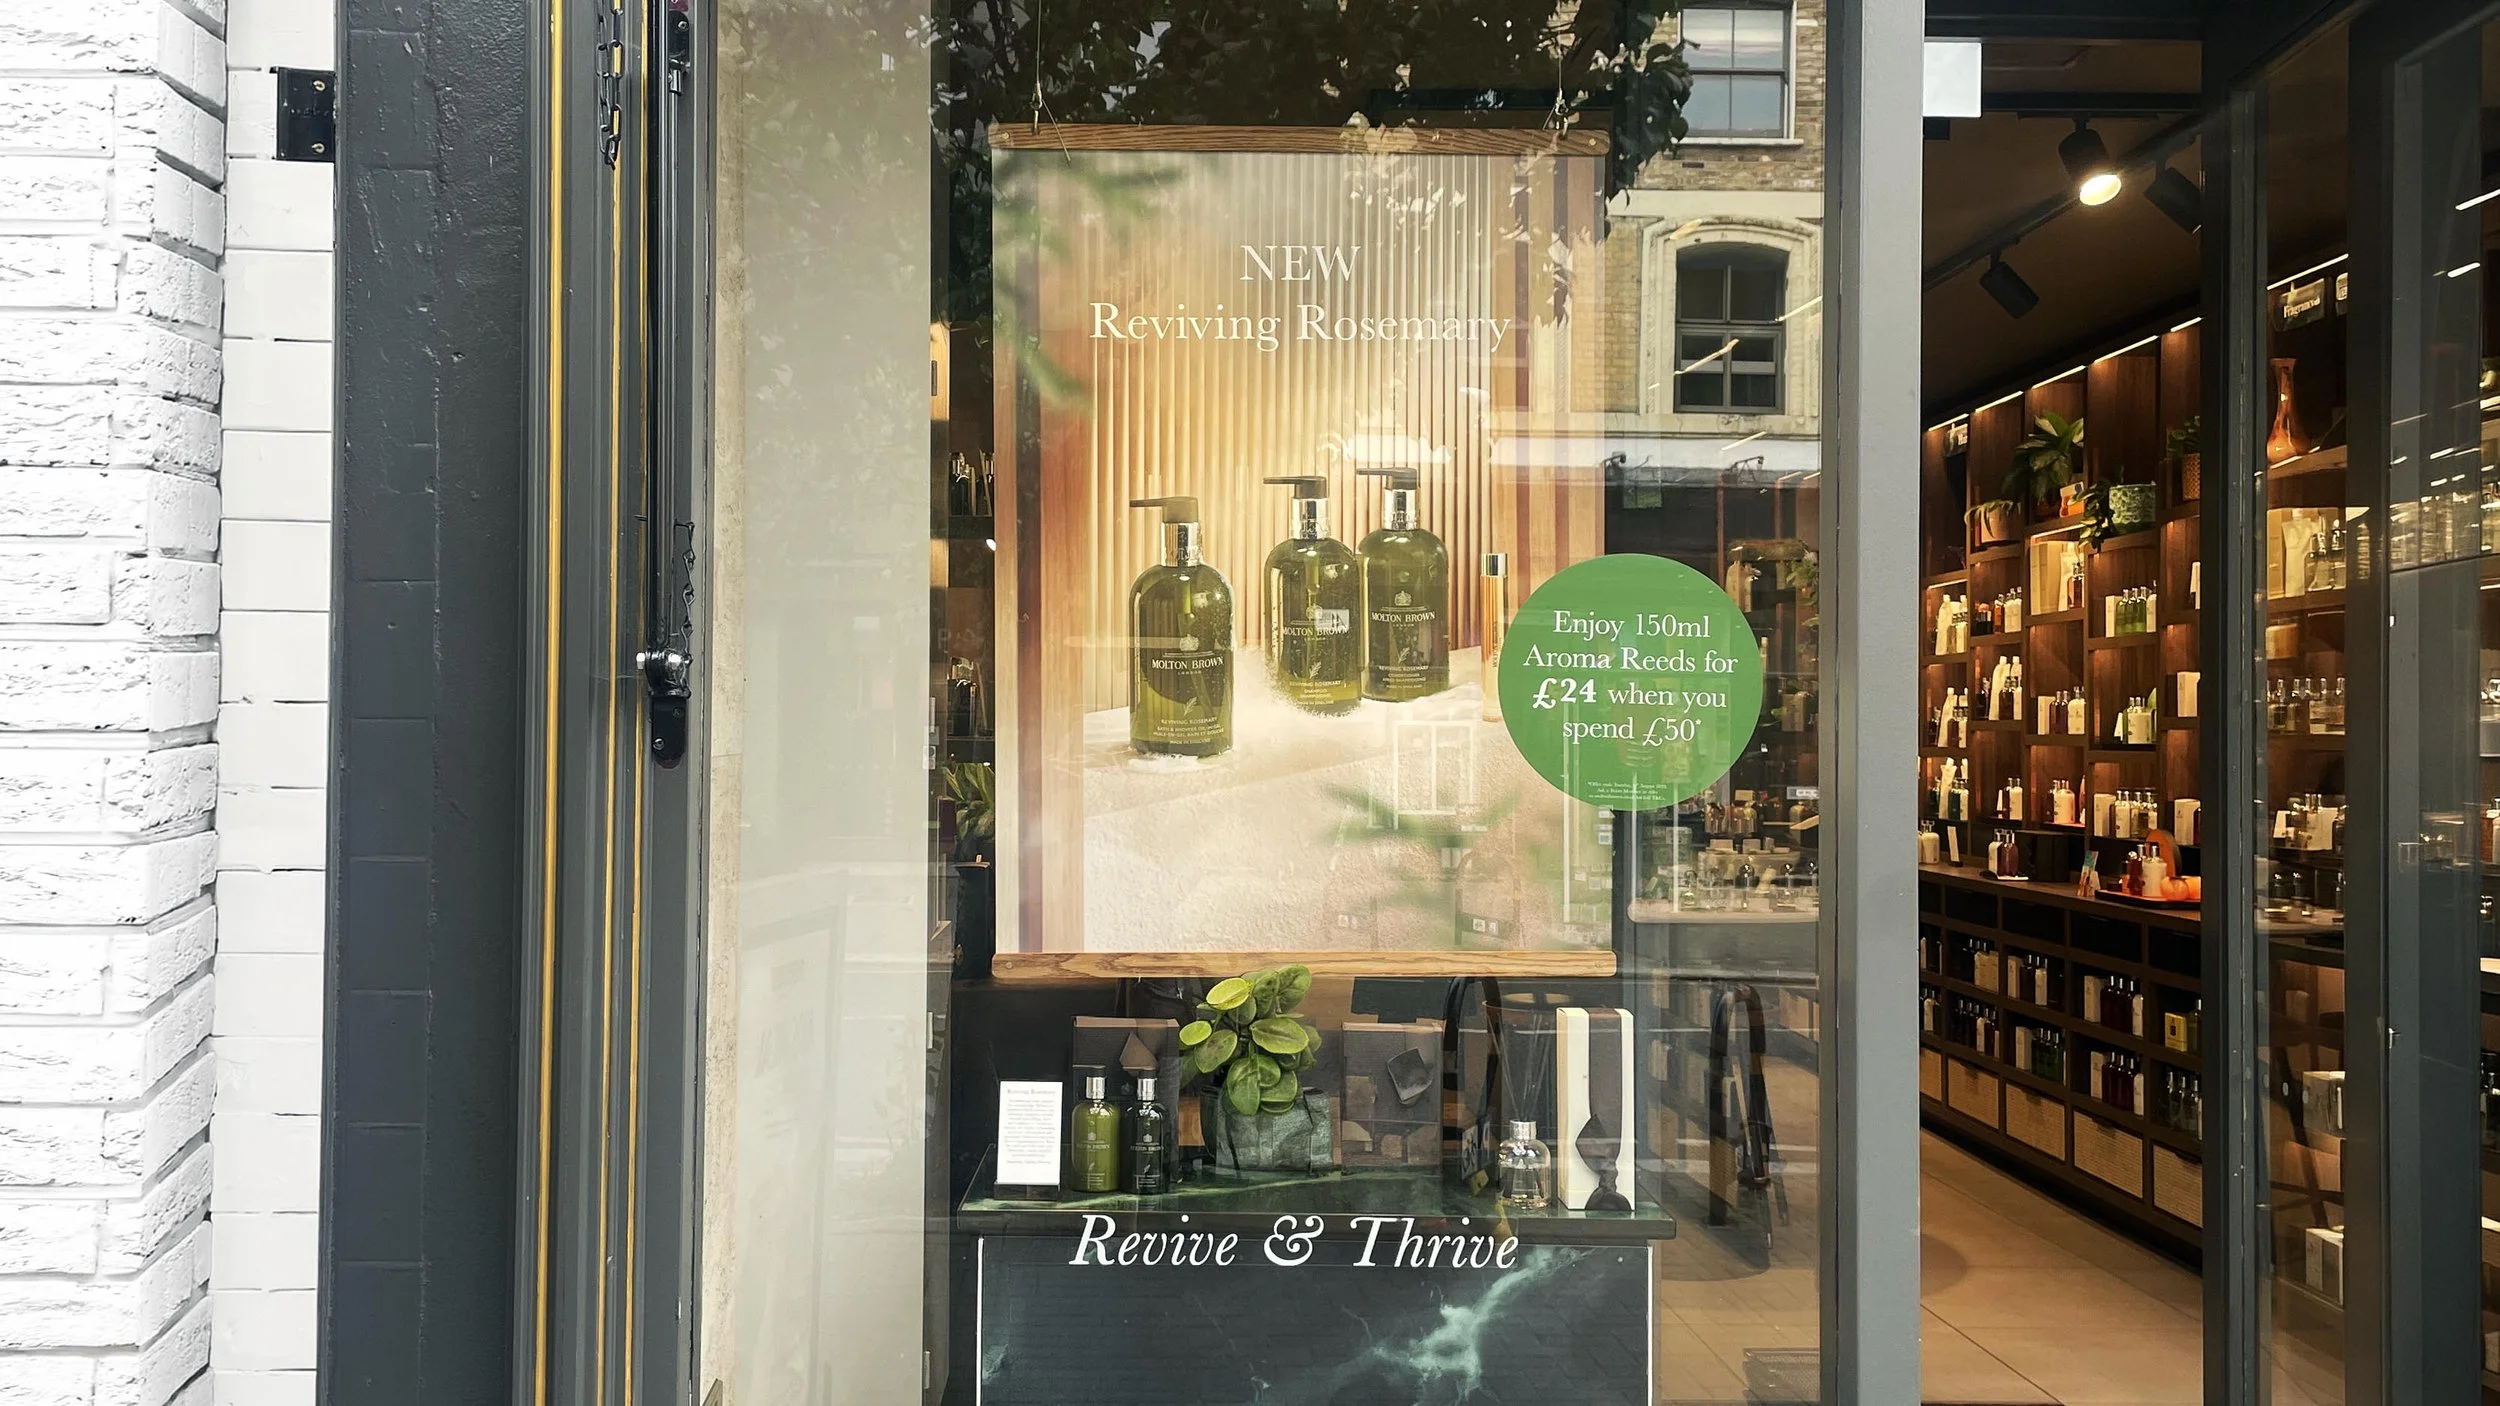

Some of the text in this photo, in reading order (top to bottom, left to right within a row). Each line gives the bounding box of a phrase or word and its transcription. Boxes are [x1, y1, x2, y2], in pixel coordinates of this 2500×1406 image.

[1239, 245, 1361, 282] NEW
[1089, 302, 1513, 352] Reviving Rosemary
[1317, 625, 1349, 636] BROWN
[1371, 611, 1436, 622] MOLTON BROWN
[1553, 610, 1711, 642] Enjoy 150ml
[1151, 656, 1225, 670] MOLTON BROWN
[1523, 644, 1739, 674] Aroma Reeds for
[1532, 677, 1727, 714] £24 when you
[1563, 717, 1634, 744] spend
[1068, 1213, 1519, 1269] Revive & Thrive
